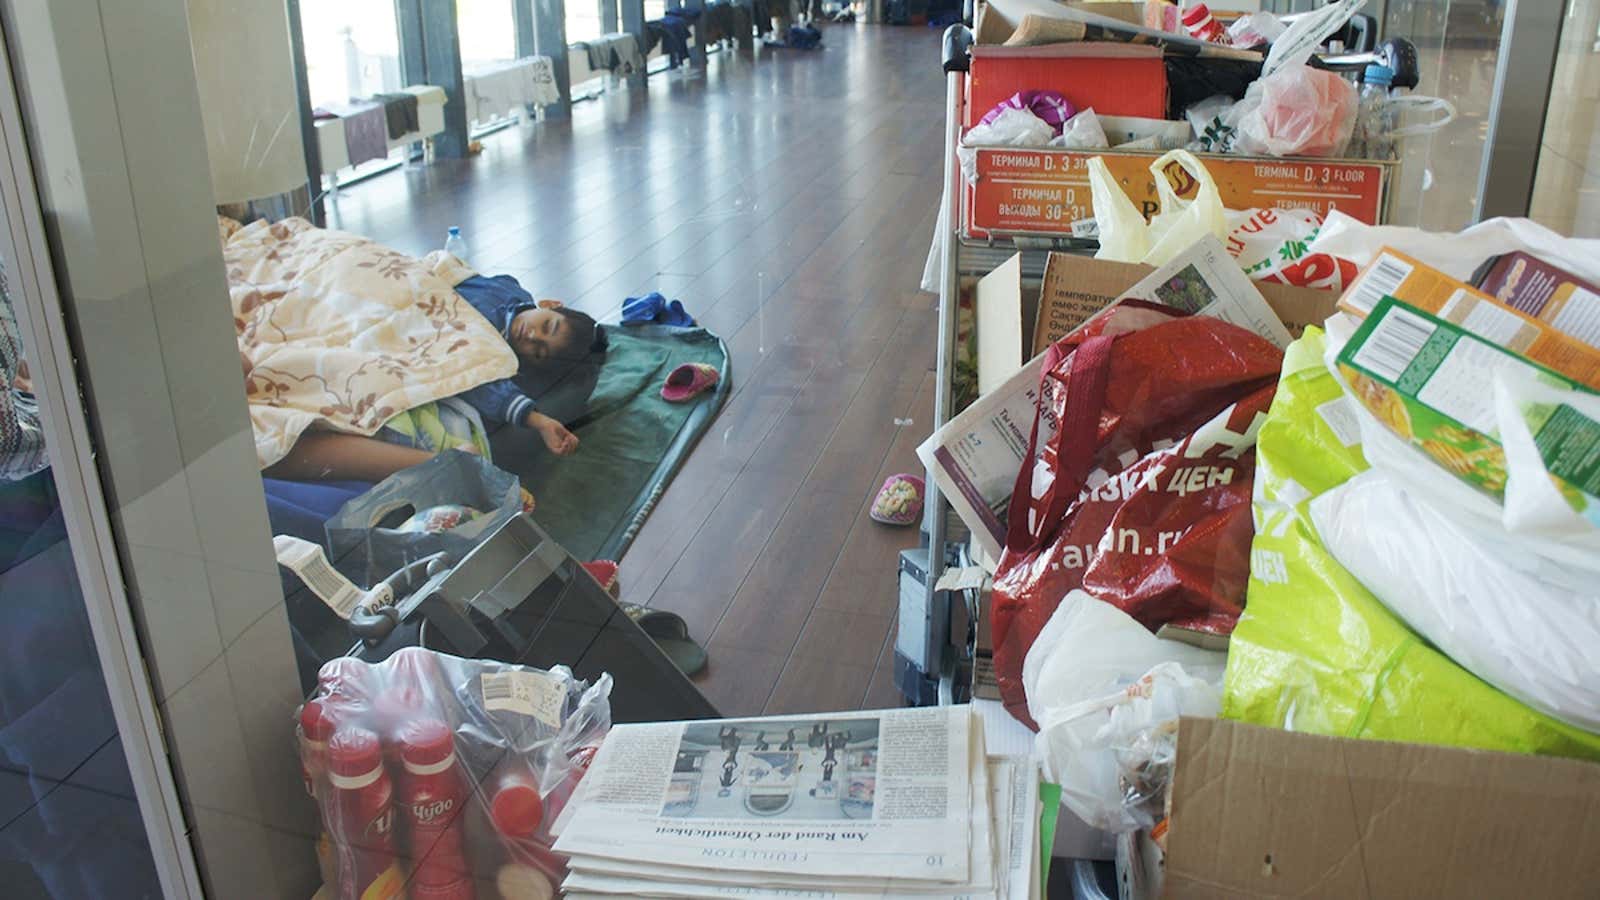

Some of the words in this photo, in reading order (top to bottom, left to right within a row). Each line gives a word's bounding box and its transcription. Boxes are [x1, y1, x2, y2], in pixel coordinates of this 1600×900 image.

[991, 154, 1041, 168] ТЕРМИНАЛ
[1044, 156, 1057, 171] D.
[1061, 155, 1070, 172] 3
[1253, 166, 1299, 179] TERMINAL
[1321, 167, 1330, 183] 3
[1334, 169, 1365, 181] FLOOR
[1066, 188, 1075, 204] D
[998, 203, 1041, 217] ВЫХОДЫ
[1045, 204, 1086, 221] 30-31
[1166, 466, 1235, 498] ЦЕН
[413, 799, 454, 821] Чудо
[656, 826, 761, 842] Öffentlichkeit
[765, 832, 791, 841] der
[795, 832, 836, 841] Rand
[842, 832, 869, 841] Am
